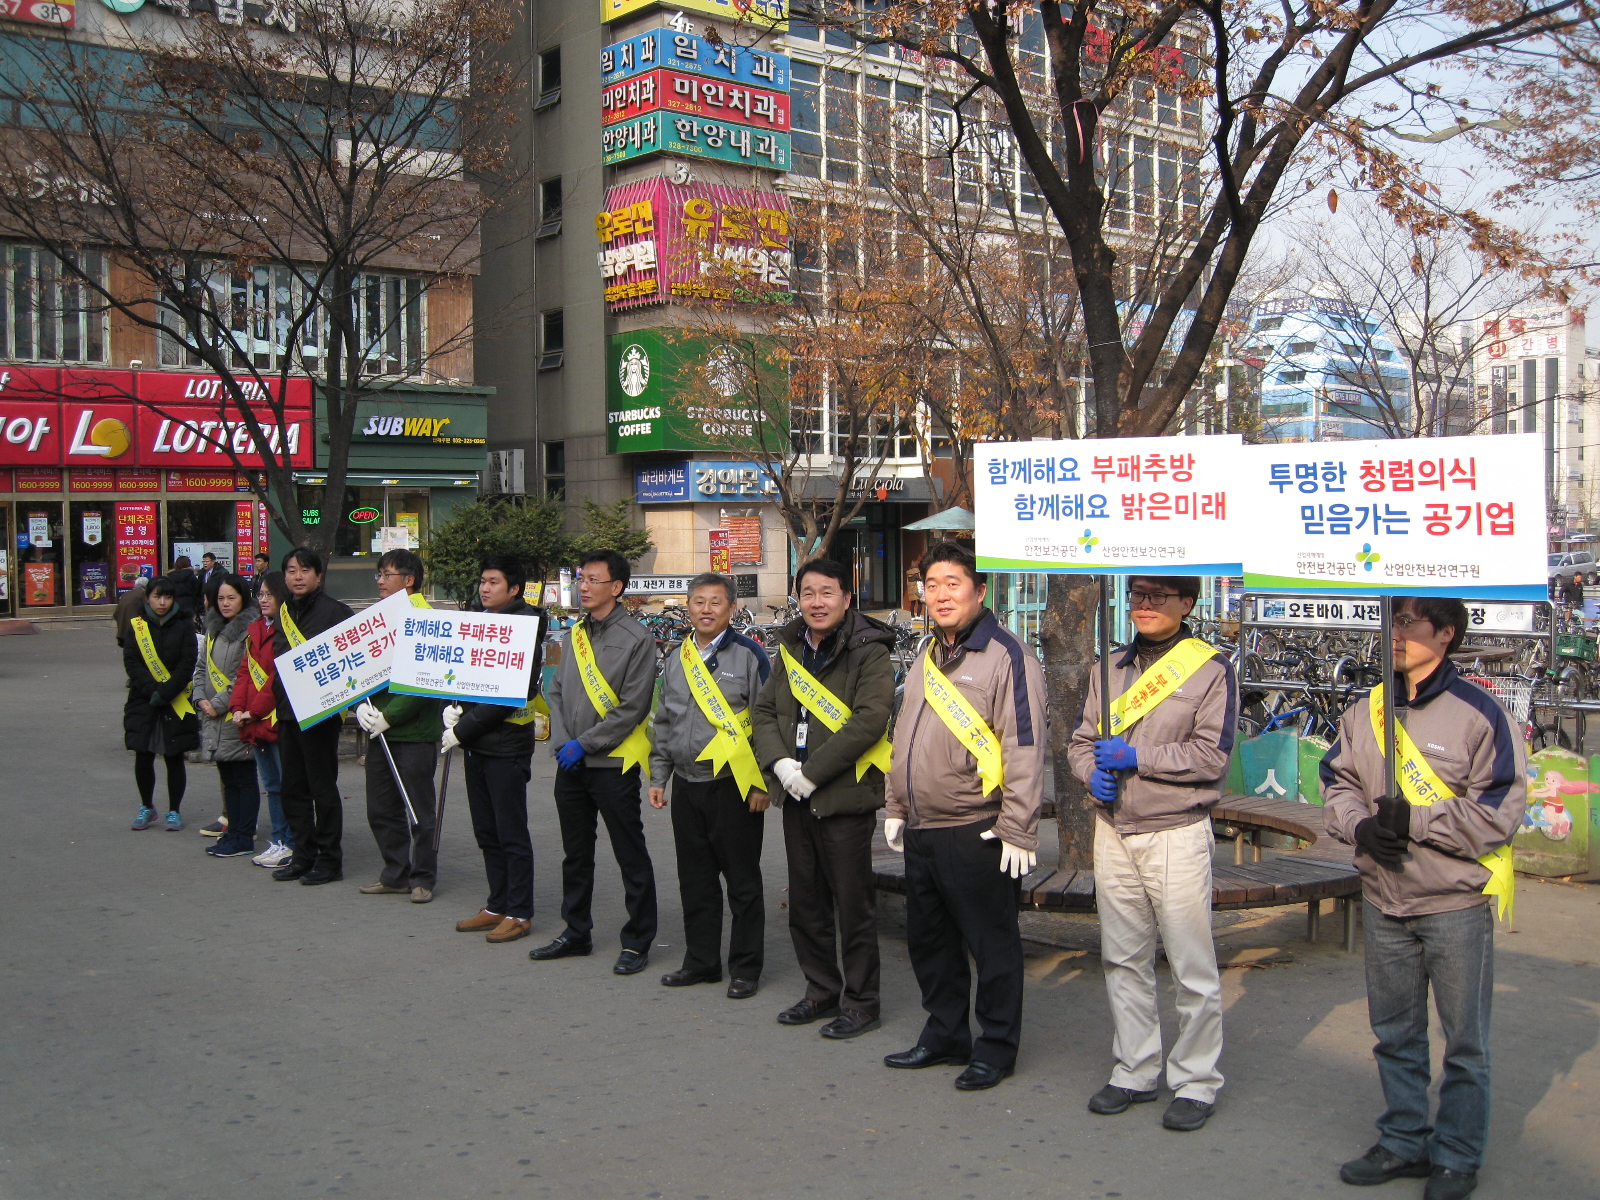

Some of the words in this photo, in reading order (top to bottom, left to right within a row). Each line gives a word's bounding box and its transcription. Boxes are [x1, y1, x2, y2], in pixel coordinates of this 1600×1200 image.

[40, 3, 61, 20] 3F
[667, 57, 703, 71] 321-2875
[602, 75, 656, 111] 미인치과
[673, 77, 778, 123] 미인치과
[667, 99, 703, 113] 327-2812
[603, 117, 657, 152] 한양내과
[674, 118, 779, 163] 한양내과
[668, 140, 703, 154] 328-7500
[184, 379, 271, 401] LOTRIA
[608, 406, 661, 423] STARBUCKS
[687, 406, 767, 421] STARBUCKS
[0, 416, 51, 452] 아
[362, 415, 451, 437] SUBWAY
[618, 422, 652, 437] COFFEE
[702, 423, 753, 437] COFFEE
[153, 419, 300, 455] LOTTERIA
[641, 468, 685, 486] 파리바게뜨
[987, 456, 1081, 485] 함께해요
[1091, 452, 1195, 484] 부패추방
[1268, 460, 1347, 494] 투명한
[1359, 456, 1477, 492] 청렴의식
[18, 481, 60, 489] 1600-9999
[72, 481, 113, 489] 1600-9999
[119, 481, 158, 489] 1600-9999
[185, 478, 233, 487] 1600-9999
[851, 474, 904, 491] Luciola
[352, 511, 376, 521] OPEN
[1014, 493, 1110, 521] 함께해요
[1121, 491, 1227, 521] 밝은미래
[118, 514, 154, 525] 단체주문
[1301, 503, 1411, 536] 믿음가는
[1422, 501, 1515, 536] 공기업
[1024, 545, 1078, 558] 안전보건공단
[1102, 545, 1186, 558] 산업안전보건연구원
[1296, 561, 1357, 576] 안전보건공단
[1383, 563, 1481, 578] 산업안전보건연구원
[643, 579, 665, 590] 자전거
[668, 579, 683, 590] 겸용
[1352, 603, 1381, 621] 자전
[404, 617, 453, 638] 함께해요
[457, 621, 514, 644] 부패추방
[292, 642, 332, 673] 투명한
[333, 612, 387, 652] 청렴의식
[414, 643, 465, 664] 함께해요
[470, 647, 526, 671] 밝은미래
[313, 651, 366, 687] 믿음가는
[584, 663, 603, 693] 깨끗하고
[690, 663, 712, 697] 깨끗하고
[706, 695, 727, 721] 청렴한
[788, 668, 819, 701] 깨끗하고
[816, 695, 842, 721] 청렴한
[1122, 673, 1168, 714] 부패추방!
[925, 669, 950, 704] 깨끗하고
[946, 699, 973, 729] 청렴한
[970, 727, 993, 755] 사회!
[1427, 742, 1445, 751] KOSHA
